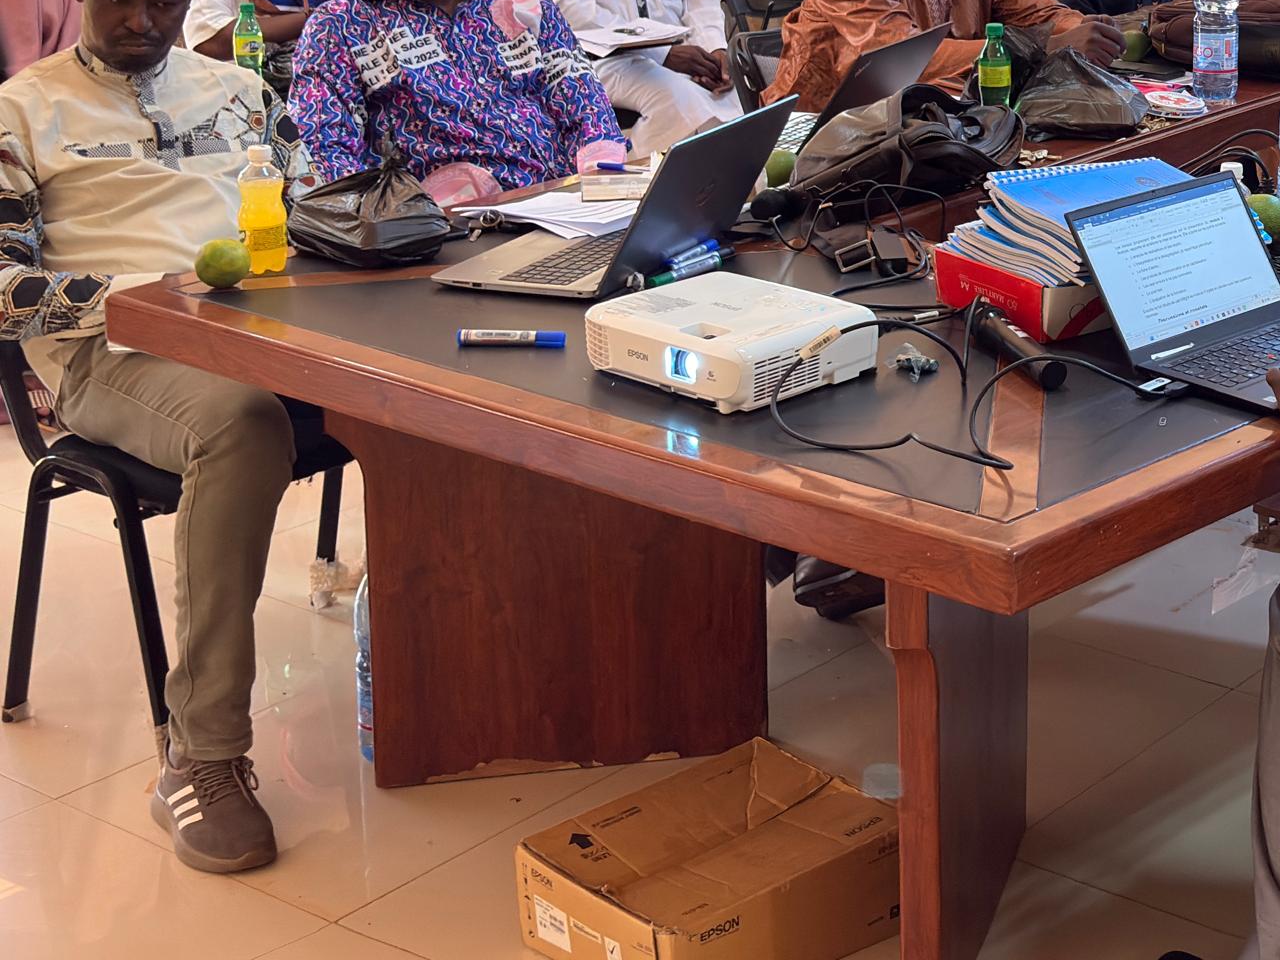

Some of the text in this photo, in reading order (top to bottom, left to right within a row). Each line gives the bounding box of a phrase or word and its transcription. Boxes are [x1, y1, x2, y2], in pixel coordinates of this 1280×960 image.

[401, 36, 433, 52] SAGE
[413, 49, 440, 64] 2025
[627, 349, 649, 362] EPSON
[700, 915, 740, 942] EPSON
